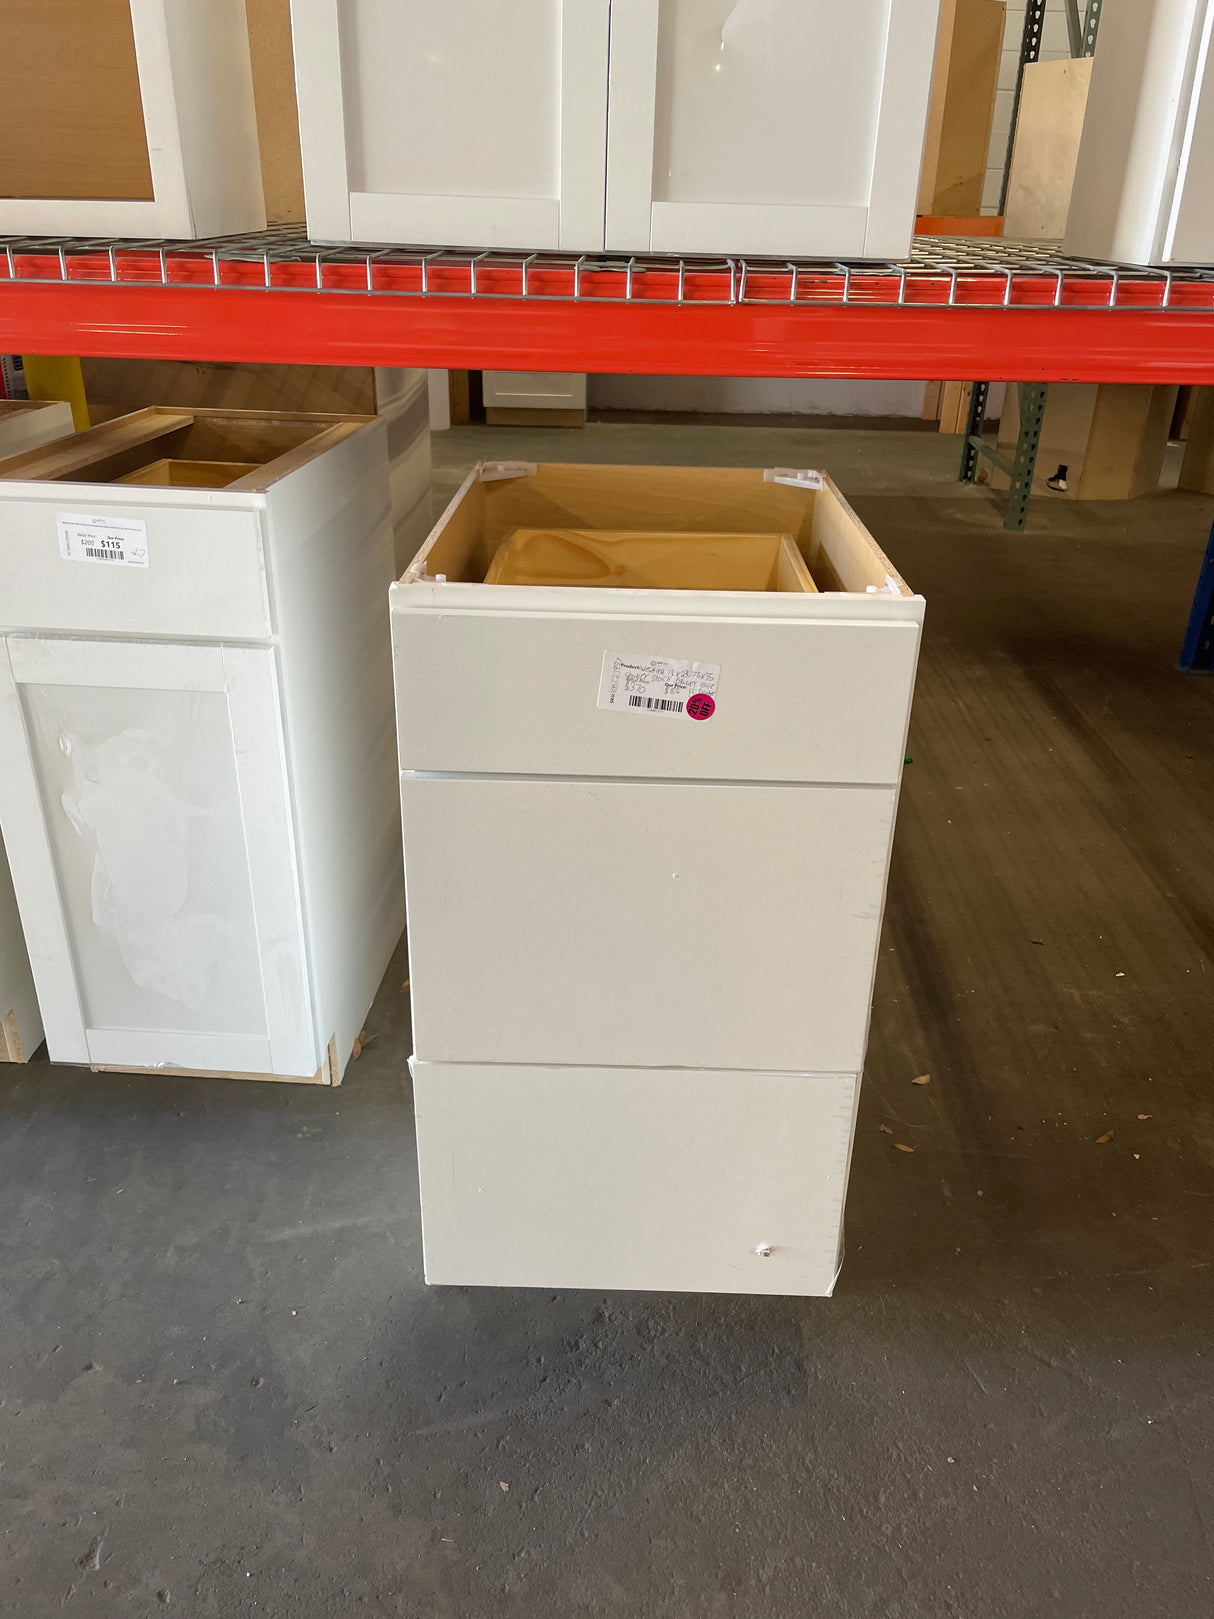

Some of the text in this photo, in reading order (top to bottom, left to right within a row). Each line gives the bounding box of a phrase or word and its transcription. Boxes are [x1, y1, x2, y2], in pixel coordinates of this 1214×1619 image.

[101, 540, 120, 549] $115
[625, 682, 646, 694] $370
[688, 697, 703, 714] 20%
[700, 702, 712, 716] OFF
